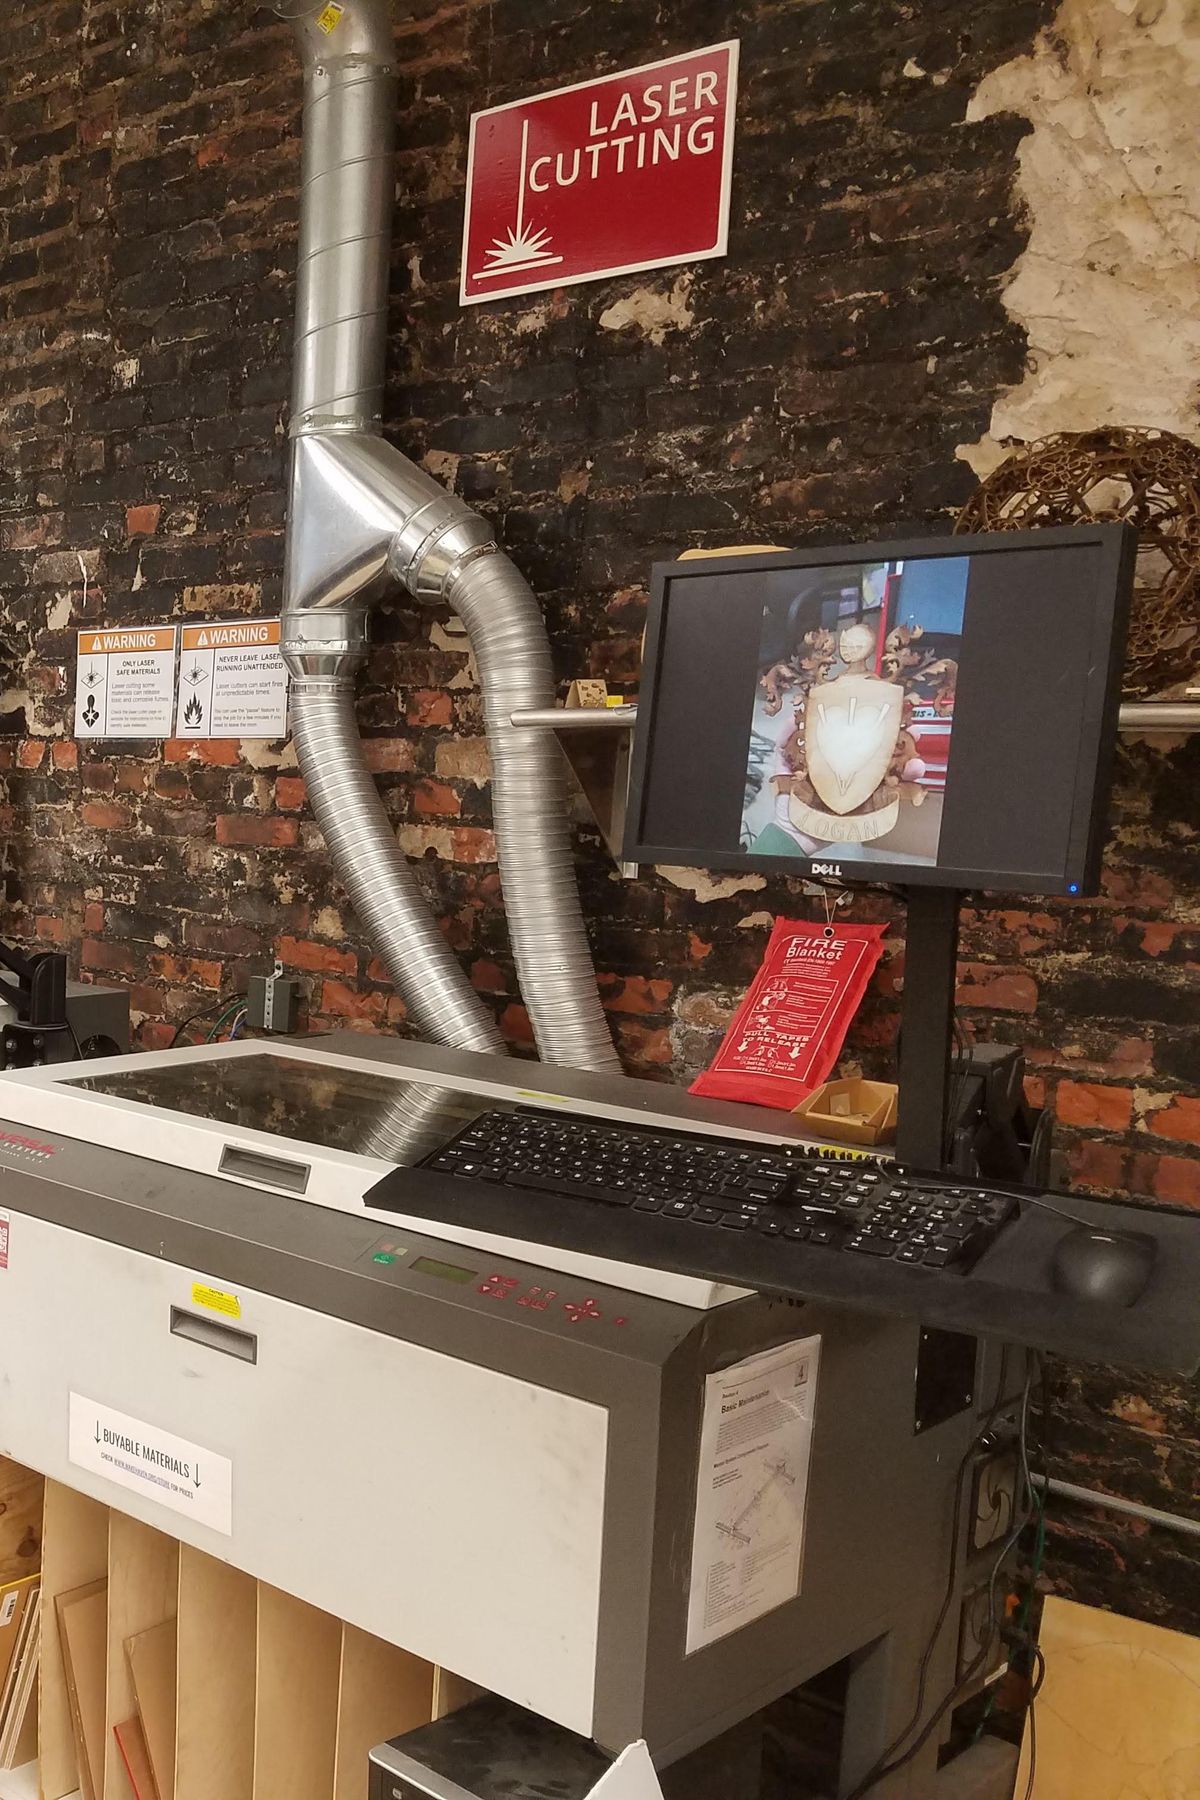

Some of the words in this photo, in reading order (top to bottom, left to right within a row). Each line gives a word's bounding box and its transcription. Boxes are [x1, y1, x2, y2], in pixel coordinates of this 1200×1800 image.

[589, 70, 719, 136] LASER
[528, 116, 715, 192] CUTTING
[103, 634, 156, 650] WARNING
[210, 627, 269, 644] WARNING
[244, 662, 283, 670] UNATTENDED
[800, 812, 879, 841] LOGAN
[812, 863, 842, 876] DELL
[791, 938, 848, 950] FIRE
[786, 946, 842, 960] Blanket
[757, 1036, 806, 1048] RELEASE
[776, 1033, 810, 1042] TAPES
[103, 1428, 140, 1456] BUYABLE
[142, 1445, 190, 1478] MATERIALS
